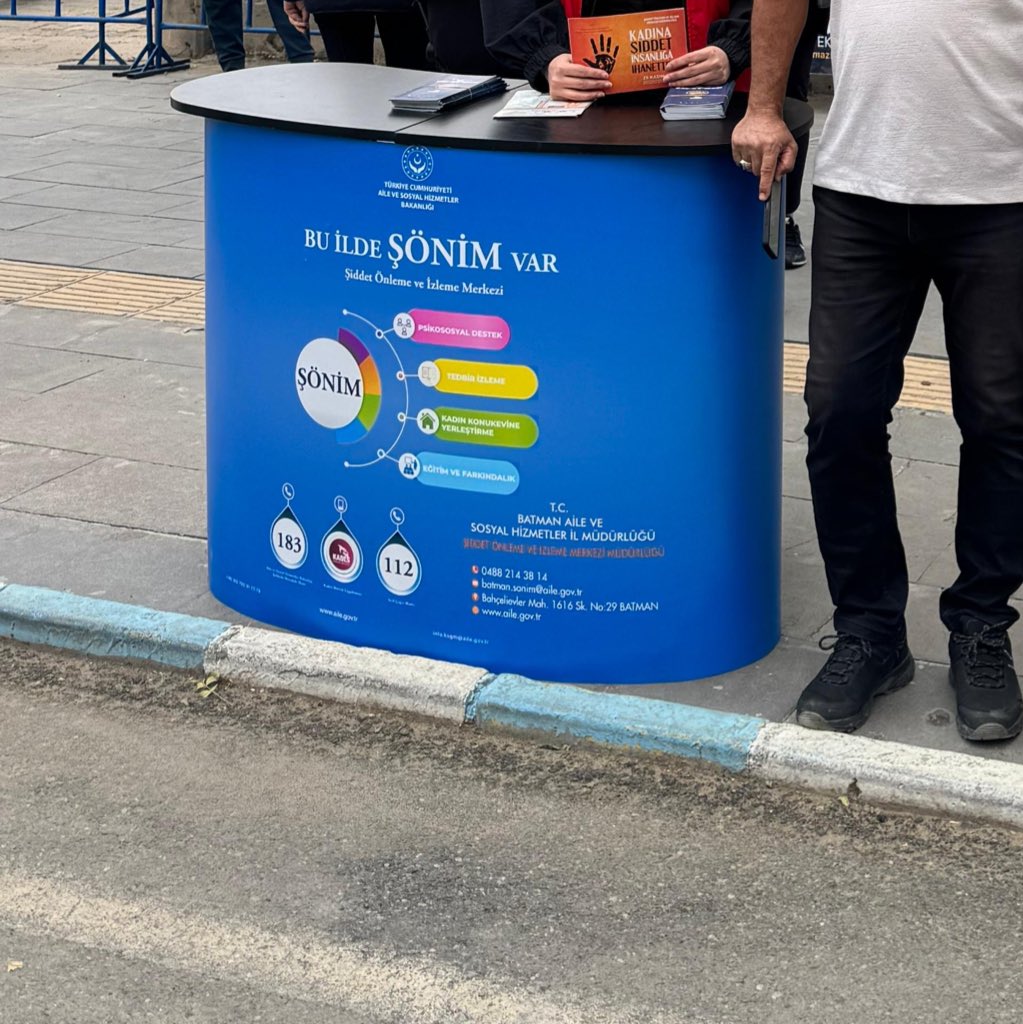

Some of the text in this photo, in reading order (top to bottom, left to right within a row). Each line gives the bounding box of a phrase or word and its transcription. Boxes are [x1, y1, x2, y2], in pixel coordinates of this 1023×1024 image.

[629, 26, 672, 42] KADINA
[384, 181, 409, 191] TÜRKİYE
[378, 189, 459, 204] AİLE VE SOSYAL HİZMETLER
[400, 201, 435, 211] BAKANLIĞI
[304, 228, 559, 273] BU İLDE ŞÖNİM VAR
[344, 268, 504, 296] Şiddet Önleme ve İzleme Merkezi
[418, 323, 502, 339] PSİKOSOSYAL DESTEK
[298, 365, 361, 397] ŞÖNİM
[441, 415, 520, 429] KADIN KONUKEVİNE
[441, 424, 494, 437] YERLEŞTİRME
[423, 465, 516, 483] EĞİTİM VE FARKINDALIK
[549, 502, 569, 513] T.C.
[517, 513, 603, 528] BATMAN AİLE VE
[471, 522, 656, 542] SOSYAL HİZMETLER İL MÜDÜRLÜĞÜ
[277, 532, 302, 553] 183
[385, 557, 413, 577] 112
[481, 566, 548, 581] 0488 214 38 14
[528, 598, 549, 609] Mah.
[552, 600, 574, 610] 1616
[575, 601, 587, 611] Sk.
[590, 602, 617, 612] No:29
[619, 601, 659, 612] BATMAN
[482, 607, 541, 622] www.aile.gov.tr
